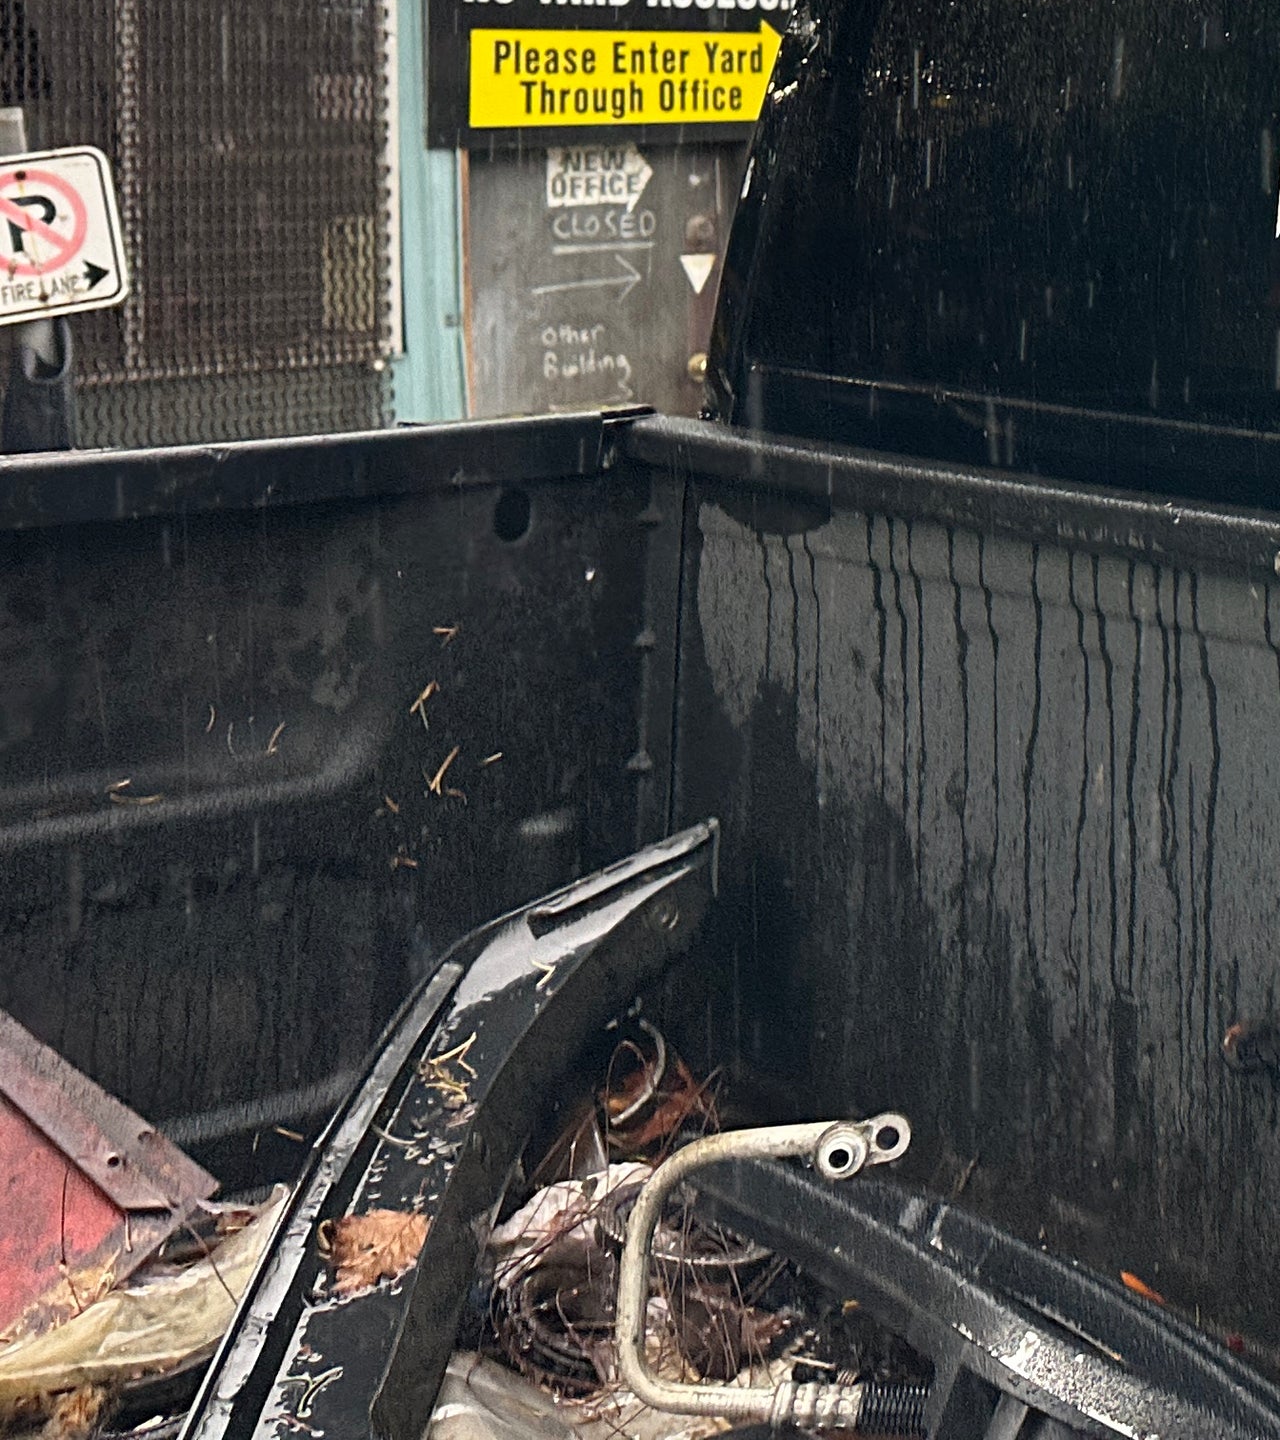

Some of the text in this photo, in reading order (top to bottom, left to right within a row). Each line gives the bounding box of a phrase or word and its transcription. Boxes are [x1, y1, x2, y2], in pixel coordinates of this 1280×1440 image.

[493, 40, 763, 75] Please Enter Yard
[520, 79, 742, 119] Through Office
[563, 147, 626, 172] NEW
[551, 173, 641, 199] OFFICE
[552, 210, 657, 239] CLOSED
[1, 280, 36, 306] FIRE
